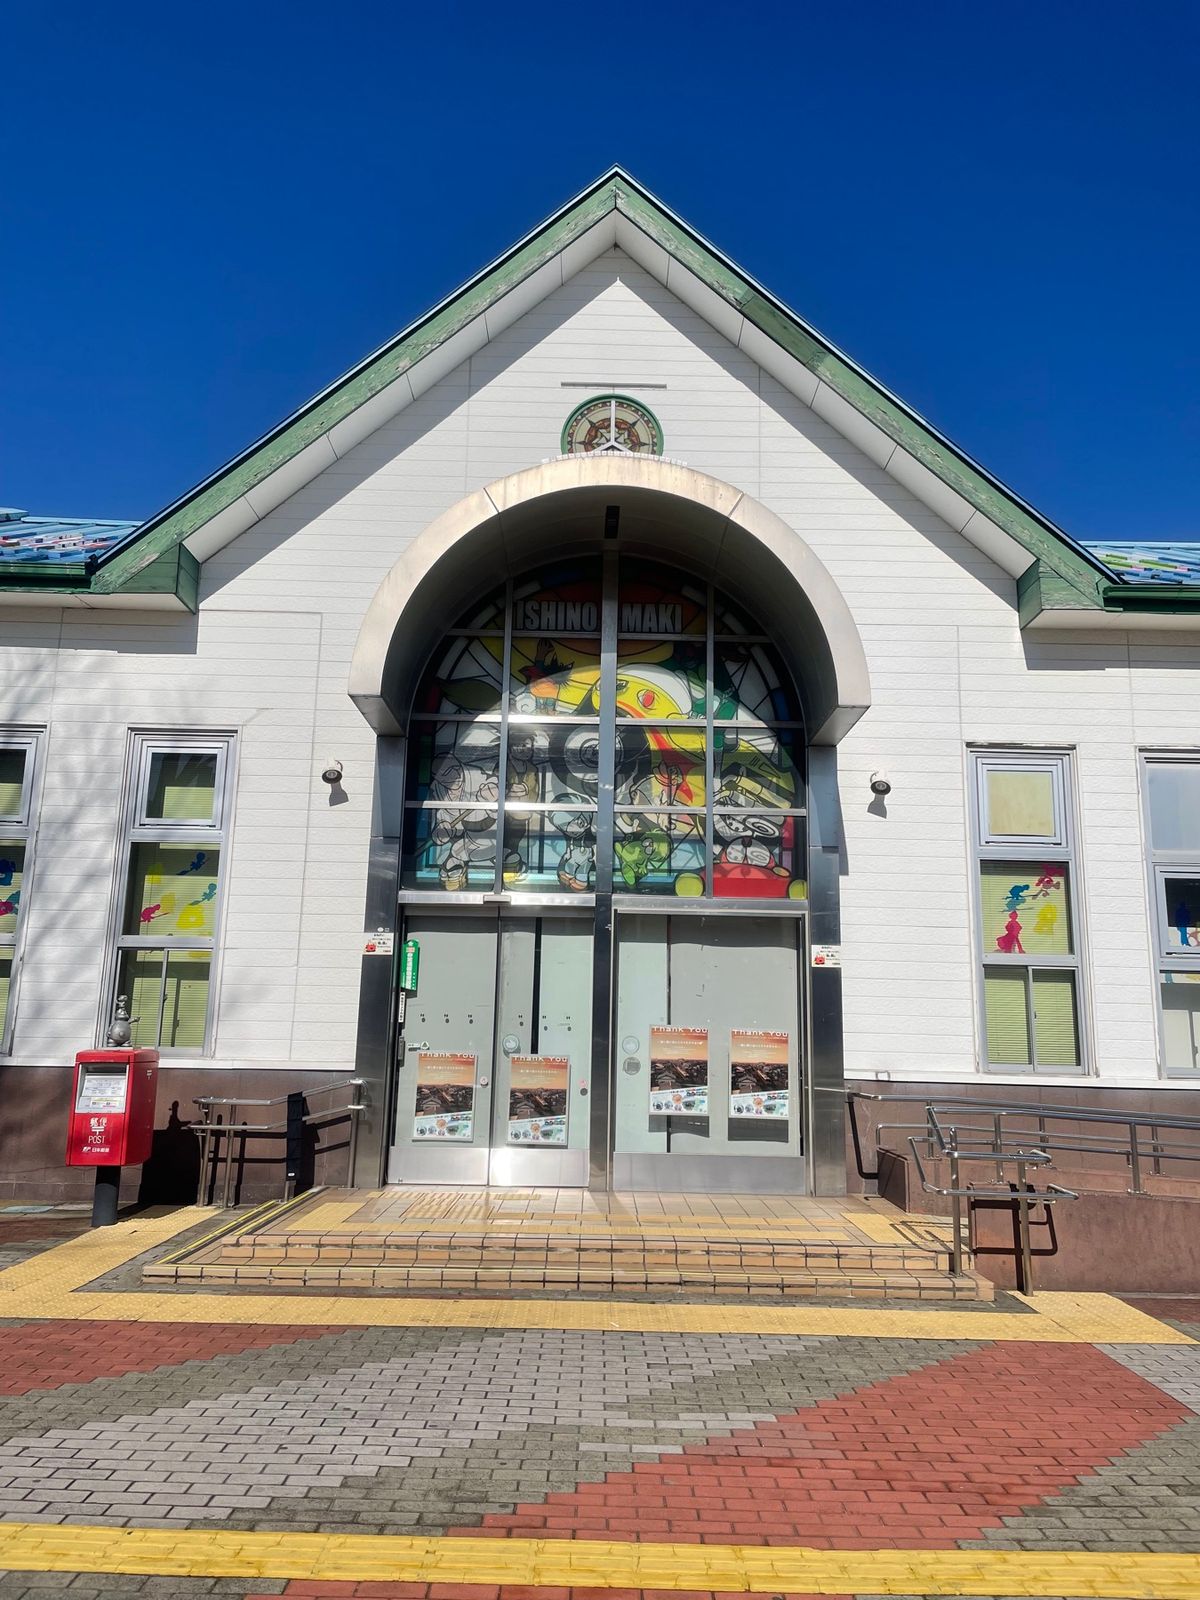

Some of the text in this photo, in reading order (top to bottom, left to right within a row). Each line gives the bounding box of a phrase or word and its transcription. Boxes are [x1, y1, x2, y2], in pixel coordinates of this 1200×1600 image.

[515, 601, 682, 633] ISHINO MAKI
[652, 1025, 684, 1033] Thank
[88, 1135, 105, 1144] POST
